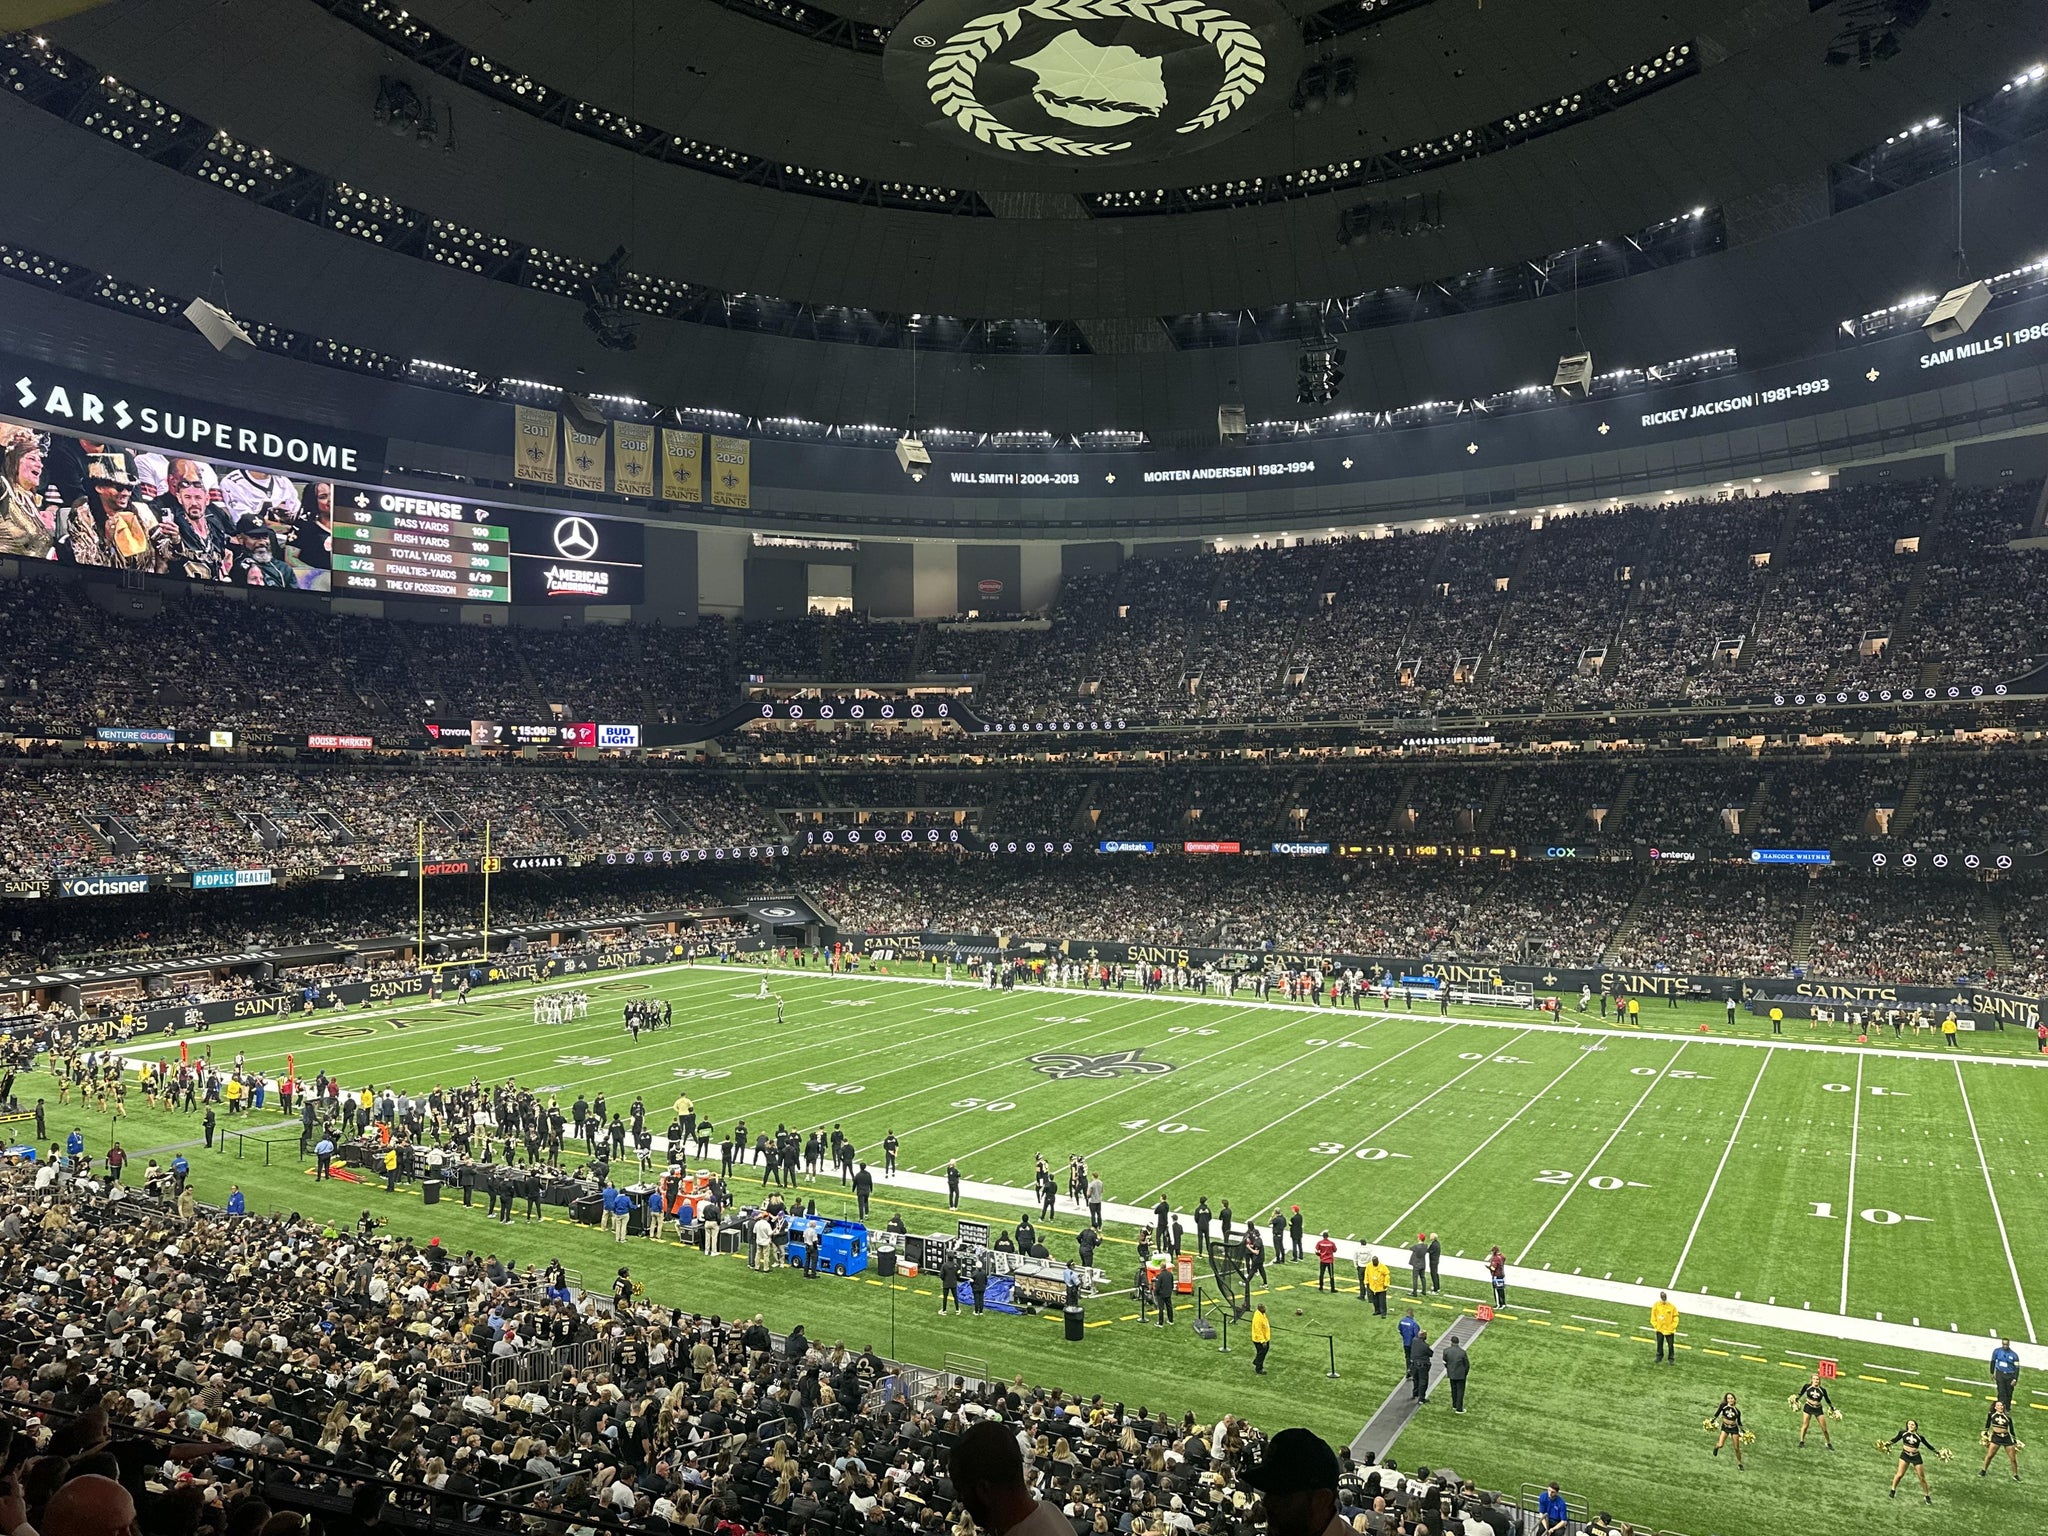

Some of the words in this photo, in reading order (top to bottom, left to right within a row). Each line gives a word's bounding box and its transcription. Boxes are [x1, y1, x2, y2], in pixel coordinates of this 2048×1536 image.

[1920, 348, 1954, 369] SAM
[1956, 336, 2004, 359] MILLS
[1641, 408, 1688, 427] RICKEY
[1690, 396, 1752, 418] JACKSON
[1761, 379, 1830, 403] 1981-1993
[523, 424, 549, 438] 2011
[140, 408, 358, 472] SUPERDOME
[572, 432, 599, 445] 2017
[621, 439, 647, 451] 2018
[669, 446, 696, 459] 2019
[716, 452, 744, 465] 2020
[518, 469, 554, 481] SAINTS
[951, 472, 978, 483] WILL
[979, 473, 1014, 484] SMITH
[1020, 473, 1080, 484] 2004-2013
[1144, 469, 1190, 483] MORTEN
[1192, 466, 1251, 480] ANDERSEN
[1257, 461, 1315, 475] 1982-1994
[567, 477, 602, 490] SAINTS
[617, 483, 651, 496] SAINTS
[664, 489, 699, 501] SAINTS
[713, 495, 747, 507] SAINTS
[380, 494, 463, 520] OFFENSE
[354, 512, 372, 523] 139
[394, 518, 418, 529] PASS
[419, 521, 450, 533] YARDS
[471, 527, 490, 537] 100
[355, 528, 370, 539] 62
[394, 534, 418, 544] RUSH
[419, 536, 450, 548] YARDS
[471, 542, 490, 552] 100
[353, 544, 372, 554] 201
[390, 548, 421, 561] TOTAL
[422, 551, 453, 563] YARDS
[470, 557, 490, 567] 200
[350, 559, 375, 571] 3/22
[386, 564, 457, 580] PENALTIES-YARDS
[468, 572, 492, 583] 5/39
[545, 565, 609, 586] AMERICAS
[386, 580, 404, 589] TIME
[404, 581, 414, 591] OF
[414, 582, 457, 596] POSSESSION
[1614, 702, 1649, 710] SAINTS
[1888, 722, 1927, 731] SAINTS
[1976, 719, 2016, 728] SAINTS
[44, 725, 82, 736] SAINTS
[99, 730, 140, 739] VENTURE
[140, 732, 174, 741] GLOBAL
[240, 732, 273, 742] SAINTS
[440, 728, 470, 737] TOYOTA
[493, 726, 503, 738] 7
[518, 725, 547, 736] 15:00
[561, 728, 576, 740] 16
[606, 727, 631, 736] BUD
[309, 736, 338, 746] ROUSES
[339, 737, 372, 747] MARKETS
[380, 737, 409, 746] SAINTS
[601, 735, 636, 745] LIGHT
[1446, 735, 1495, 745] SUPERDOME
[1118, 843, 1147, 851] Allstate
[1186, 842, 1220, 852] Community
[1280, 843, 1328, 854] Ochsner
[1600, 849, 1632, 857] SAINTS
[568, 853, 596, 863] SAINTS
[1660, 851, 1695, 861] entergy
[360, 863, 392, 873] SAINTS
[421, 861, 468, 875] verizon
[512, 857, 563, 869] CAESARS
[285, 866, 320, 877] SAINTS
[195, 873, 235, 886] PEOPLES
[237, 871, 270, 884] HEALTH
[5, 880, 50, 894] SAINTS
[73, 880, 147, 896] Ochsner
[1127, 945, 1189, 963] SAINTS
[107, 950, 281, 975] SUPERDOME
[1422, 963, 1501, 983] SAINTS
[370, 977, 423, 998] SAINTS
[1601, 973, 1690, 994] SAINTS
[1796, 983, 1897, 1001] SAINTS
[1973, 994, 2040, 1022] SAINTS
[802, 1081, 866, 1095] 40
[1822, 1083, 1893, 1097] 10
[950, 1097, 1016, 1112] 50
[1117, 1119, 1189, 1134] 40
[1308, 1141, 1389, 1161] 30
[1532, 1169, 1624, 1191] 20
[1807, 1201, 1903, 1225] 10
[1035, 1290, 1067, 1304] SAINTS
[1821, 1362, 1834, 1377] 10
